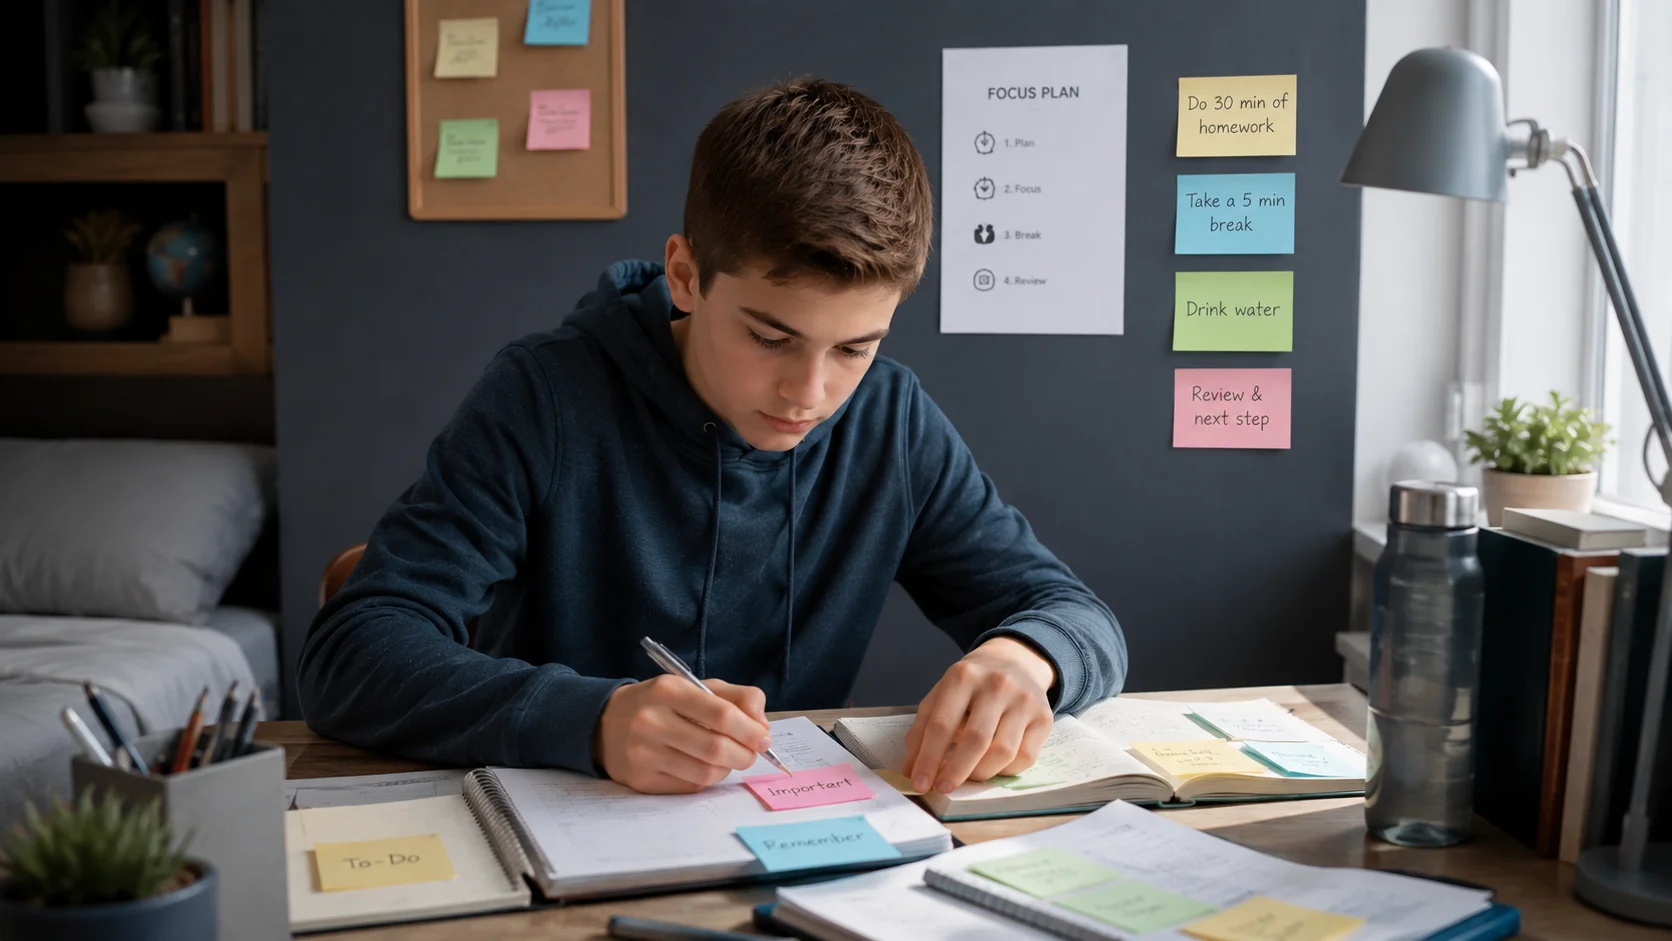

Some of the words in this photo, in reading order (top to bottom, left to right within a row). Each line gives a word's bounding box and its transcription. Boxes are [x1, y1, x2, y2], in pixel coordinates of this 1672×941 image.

[987, 86, 1037, 100] FOCUS
[1041, 86, 1080, 99] PLAN
[1188, 95, 1208, 111] Do
[1214, 95, 1234, 111] 30
[1240, 95, 1266, 109] min
[1272, 92, 1289, 109] of
[1199, 117, 1275, 134] homework
[1004, 139, 1013, 148] 1.
[1014, 138, 1035, 148] Plan
[1004, 184, 1013, 194] 2.
[1014, 184, 1042, 194] Focus
[1186, 192, 1221, 208] Take
[1226, 198, 1236, 207] a
[1242, 192, 1252, 207] 5
[1258, 193, 1286, 207] min
[1210, 216, 1253, 232] break
[1004, 231, 1013, 240] 3.
[1014, 230, 1042, 240] Break
[1003, 277, 1013, 286] 4.
[1014, 276, 1047, 286] Review
[1186, 300, 1228, 317] Drink
[1235, 301, 1281, 317] water
[1192, 385, 1245, 402] Review
[1251, 385, 1263, 402] &
[1194, 410, 1229, 426] next
[1236, 411, 1270, 431] step
[762, 831, 865, 852] Remember
[341, 853, 420, 870] To-Do
